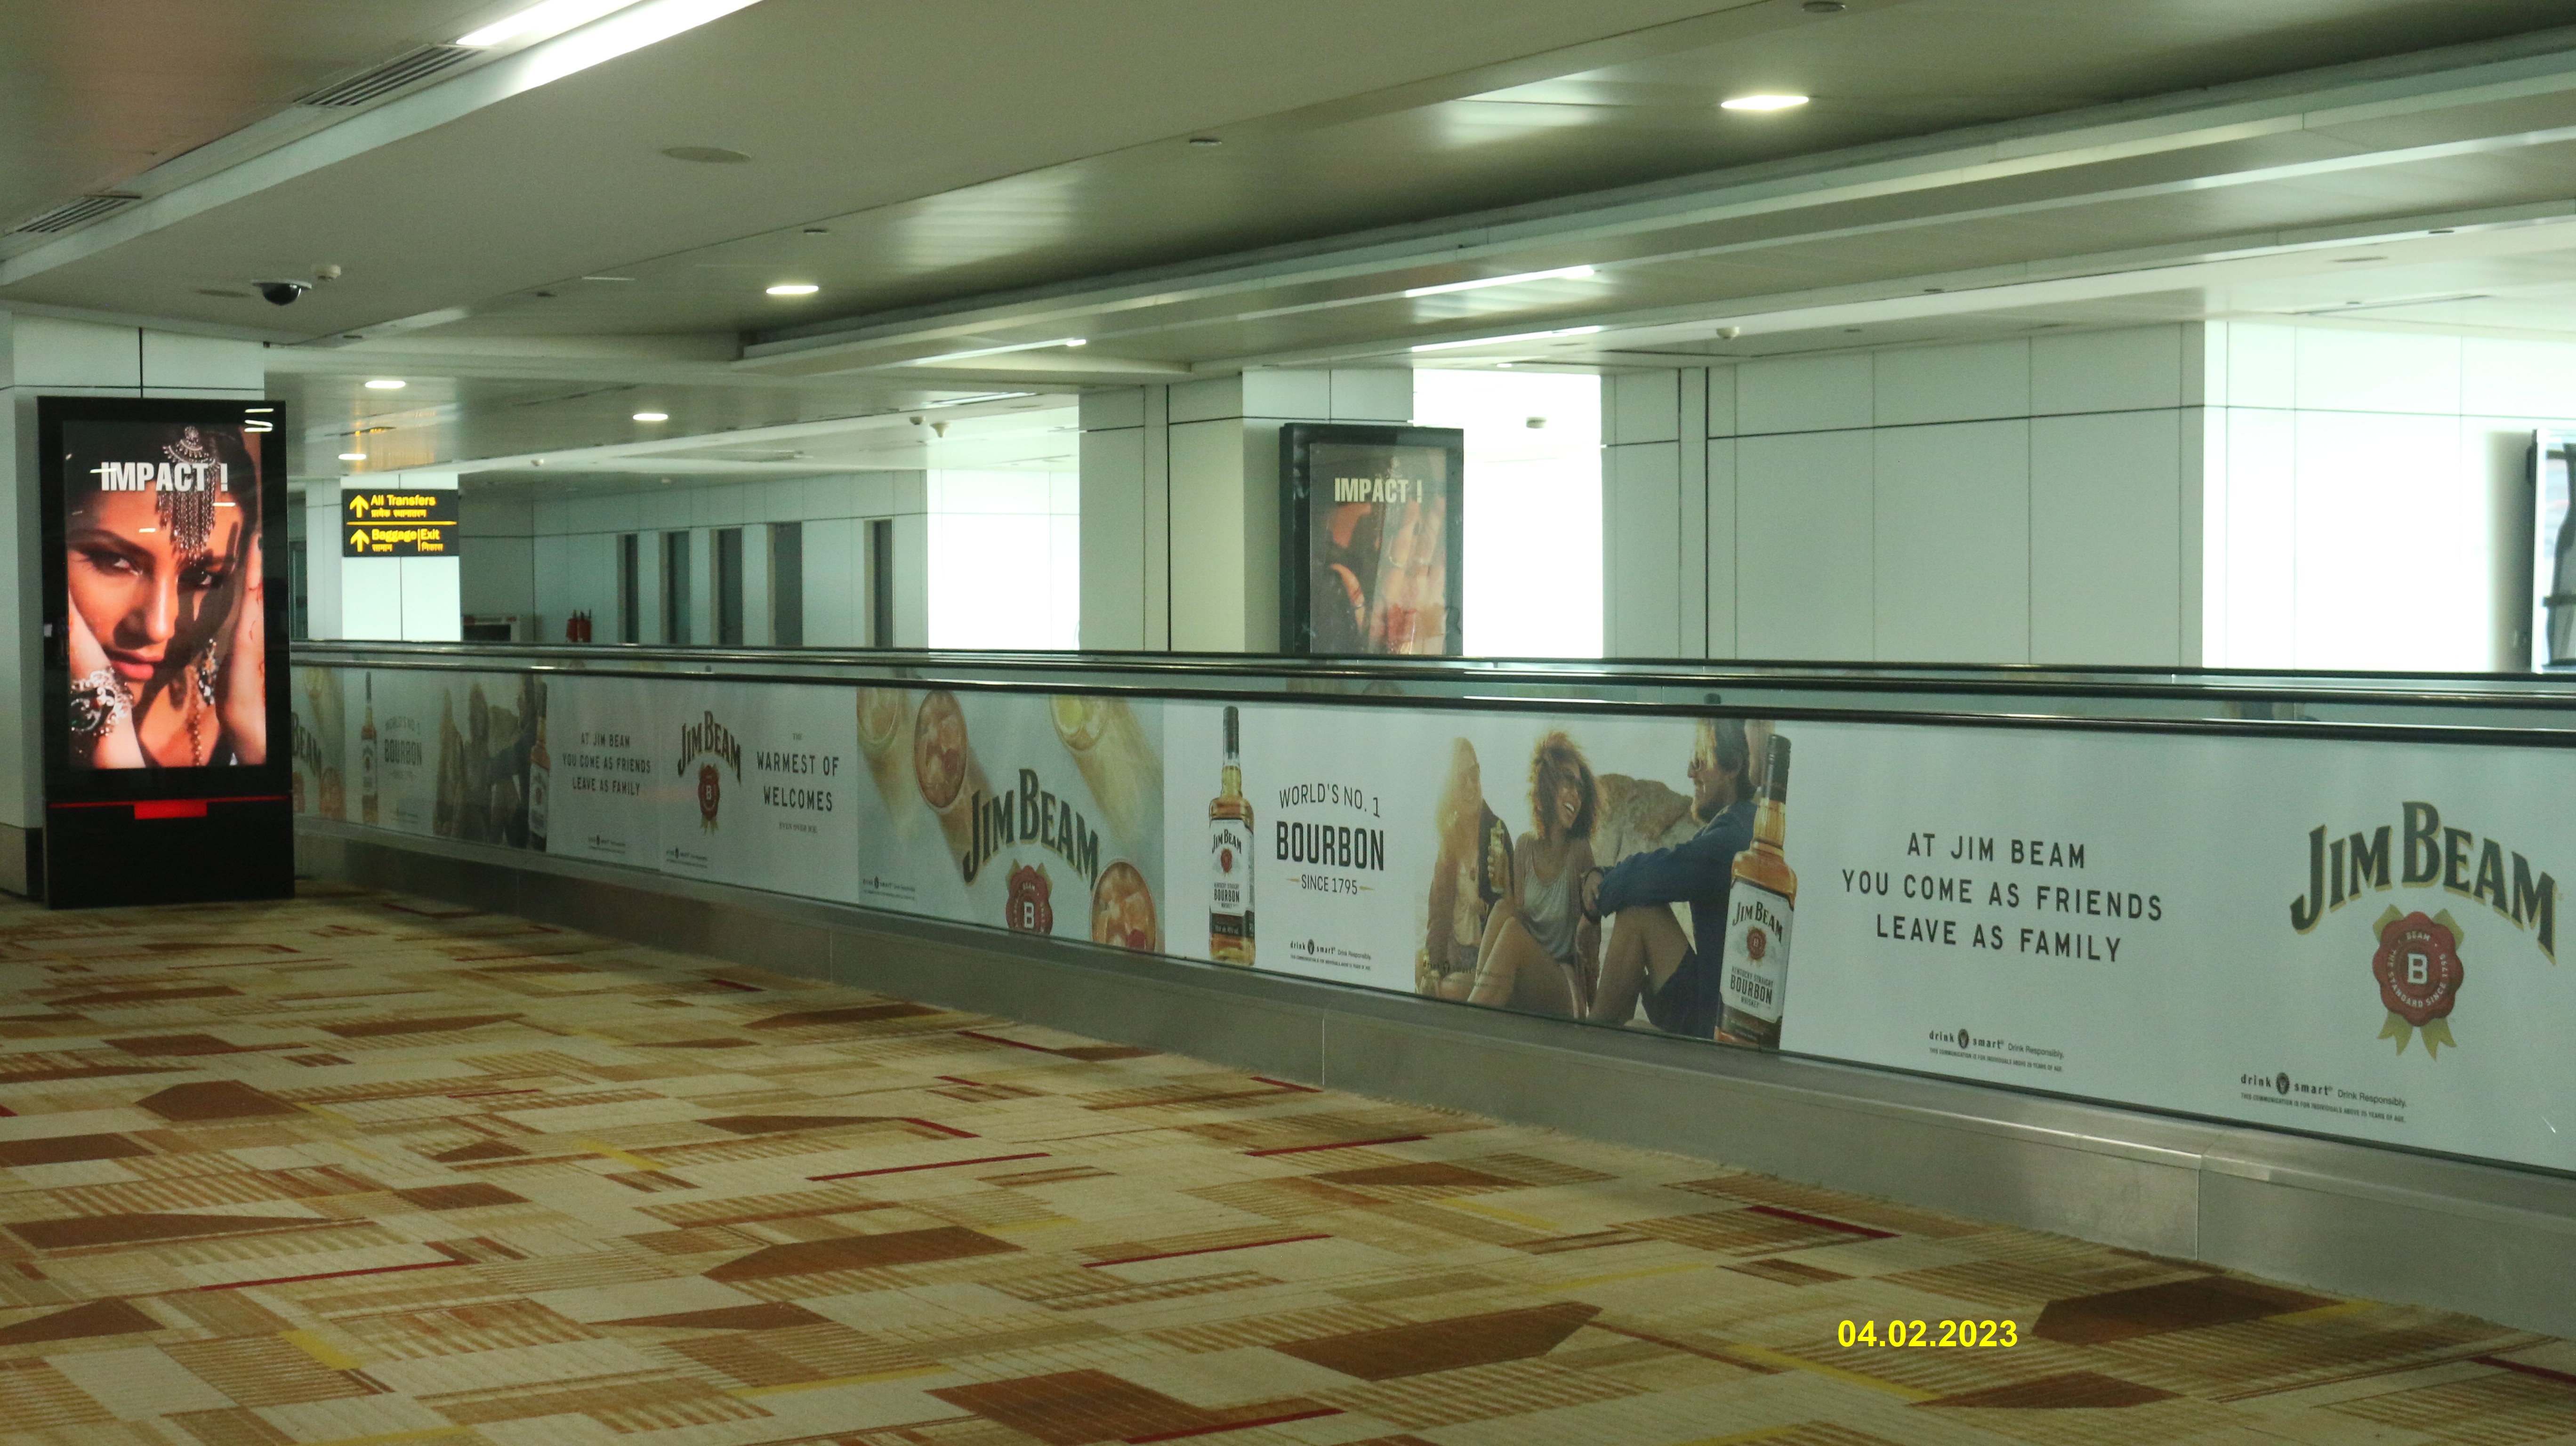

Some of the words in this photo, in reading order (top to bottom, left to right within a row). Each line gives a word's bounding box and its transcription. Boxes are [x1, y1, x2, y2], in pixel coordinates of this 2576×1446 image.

[101, 462, 208, 491] IMPACT
[1334, 477, 1409, 503] IMPACT
[370, 494, 384, 506] All
[386, 494, 437, 506] Transfers
[371, 529, 417, 543] Baggage
[421, 529, 441, 540] Exit
[581, 732, 589, 746] AT
[593, 733, 606, 747] JIM
[610, 734, 630, 748] BEAM
[677, 723, 702, 777] JIM
[704, 710, 741, 787] BEAM
[563, 754, 577, 766] YOU
[580, 755, 600, 769] COME
[604, 757, 612, 770] AS
[617, 759, 651, 774] FRIENDS
[757, 751, 816, 775] WARMEST
[823, 756, 839, 777] OF
[572, 777, 596, 792] LEAVE
[599, 780, 609, 793] AS
[612, 781, 641, 796] FAMILY
[764, 785, 833, 812] WELCOMES
[1279, 782, 1339, 809] WORLD'S
[1344, 787, 1368, 812] NO.
[1372, 796, 1380, 818] 1
[962, 789, 1015, 886] JIM
[1019, 768, 1100, 893] BEAM
[1212, 833, 1223, 854] JIM
[1224, 828, 1242, 854] BEAM
[1276, 820, 1384, 871] BOURBON
[1908, 832, 1935, 857] AT
[1951, 835, 1993, 862] JIM
[2011, 839, 2085, 869] BEAM
[1214, 889, 1240, 903] BOURBON
[1301, 875, 1329, 892] SINCE
[1332, 877, 1358, 895] 1795
[1842, 869, 1888, 895] YOU
[1903, 874, 1972, 903] COME
[1989, 882, 2020, 908] AS
[2037, 885, 2162, 921] FRIENDS
[2290, 824, 2393, 935] JIM
[2401, 801, 2557, 967] BEAM
[1023, 901, 1035, 929] B
[1732, 901, 1753, 926] JIM
[1755, 901, 1783, 944] BEAM
[1290, 940, 1306, 950] drink
[1876, 914, 1956, 945] LEAVE
[1972, 924, 2003, 950] AS
[2020, 928, 2121, 962] FAMILY
[2406, 930, 2431, 941] BEAM
[1731, 966, 1753, 980] KENTUCKY
[1754, 973, 1774, 988] STRAIGHT
[2407, 952, 2429, 985] B
[1730, 975, 1772, 1005] BOURBON
[1741, 996, 1759, 1008] WHISKEY
[2387, 971, 2424, 1009] STANDARD
[2425, 981, 2447, 1006] SINCE
[1929, 1030, 1954, 1043] drink
[1973, 1037, 2001, 1049] smart
[2008, 1042, 2024, 1052] Drink
[2241, 1073, 2271, 1088] drink
[2294, 1083, 2328, 1096] smart
[2338, 1089, 2357, 1100] Drink
